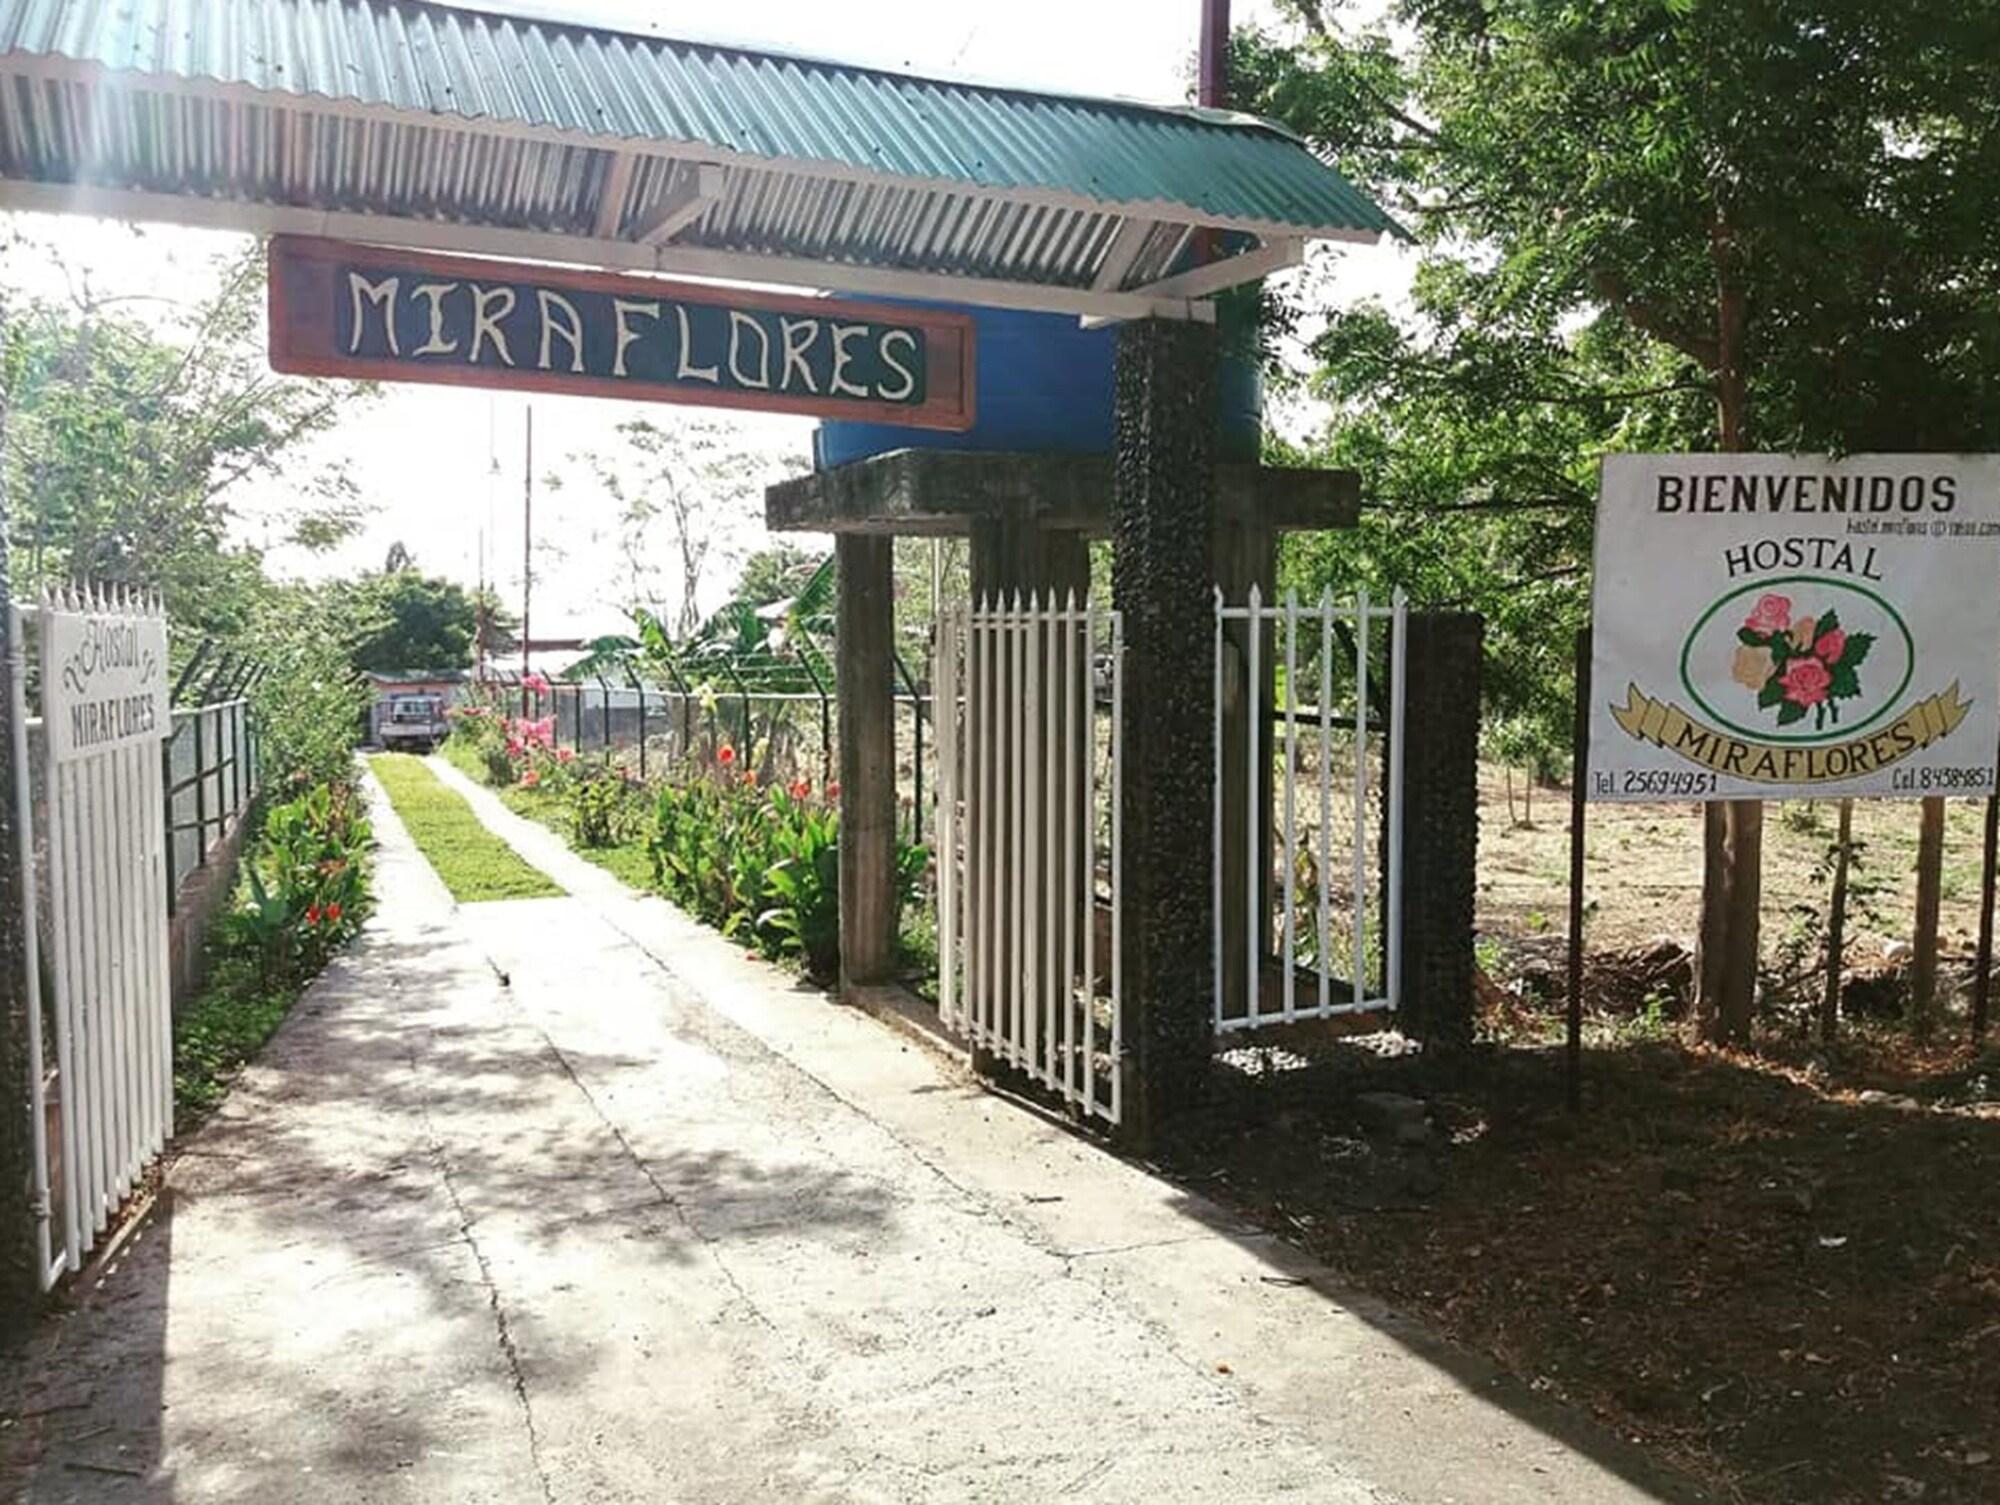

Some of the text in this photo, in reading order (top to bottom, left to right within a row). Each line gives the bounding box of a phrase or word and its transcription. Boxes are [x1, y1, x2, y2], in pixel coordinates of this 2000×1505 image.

[346, 271, 919, 403] MIRAFLORES
[1657, 476, 1957, 513] BIENVENIDOS
[1724, 537, 1883, 580] HOSTAL
[80, 618, 140, 677] Hostal
[70, 693, 155, 749] MIRAFLORES
[1675, 721, 1917, 779] MIRAFLORES
